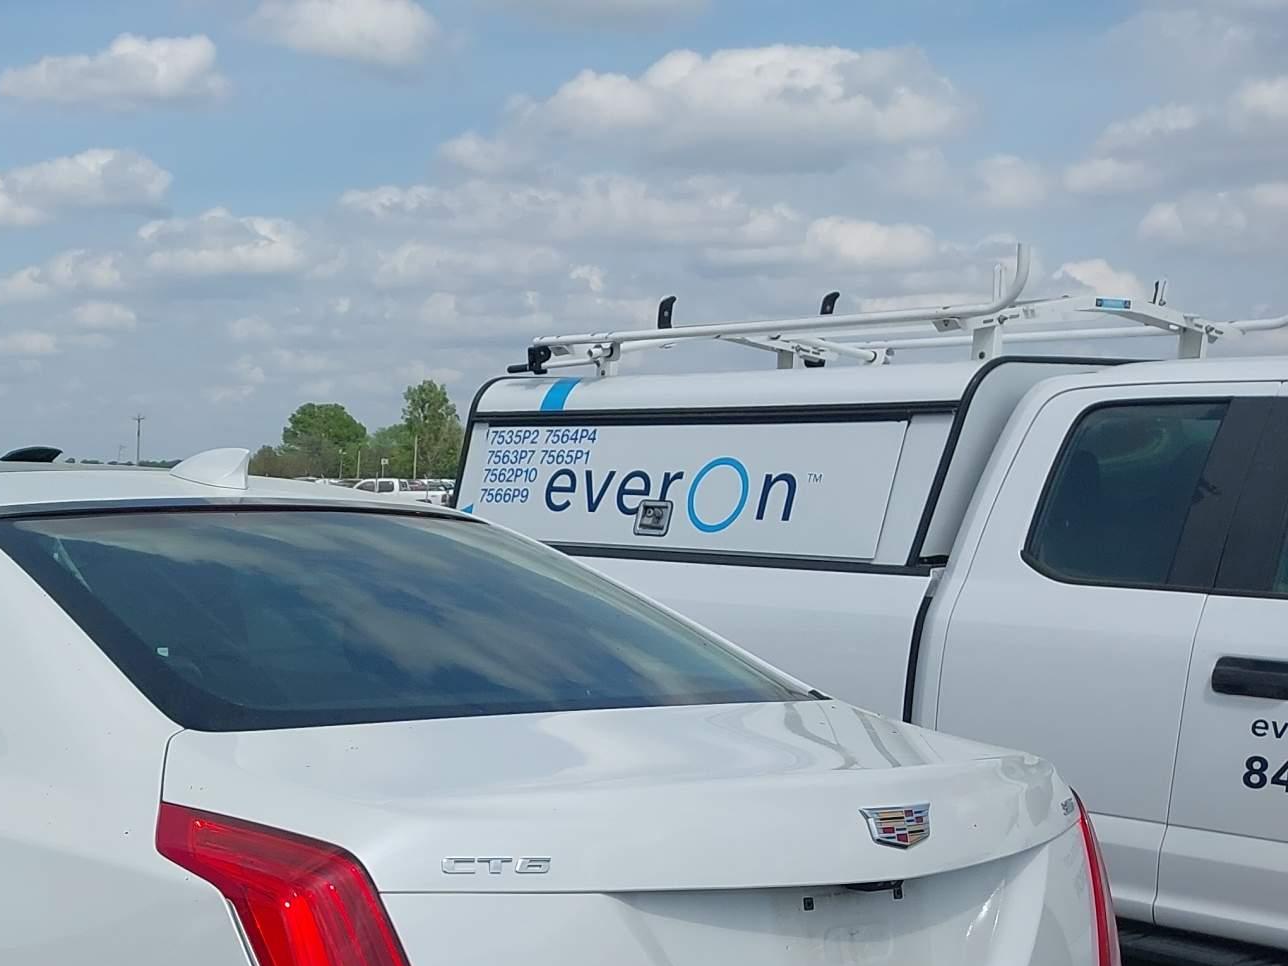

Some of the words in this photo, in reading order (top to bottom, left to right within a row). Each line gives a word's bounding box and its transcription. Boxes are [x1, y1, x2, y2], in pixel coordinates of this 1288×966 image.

[490, 429, 539, 445] 7535P2
[544, 429, 597, 443] 7564P4
[487, 450, 536, 465] 7563P7
[540, 449, 591, 465] 7565P1
[483, 467, 538, 483] 7562P10
[479, 488, 530, 504] 7566P9
[545, 456, 797, 533] everOn
[1242, 755, 1288, 792] 84
[440, 856, 552, 875] CT6
